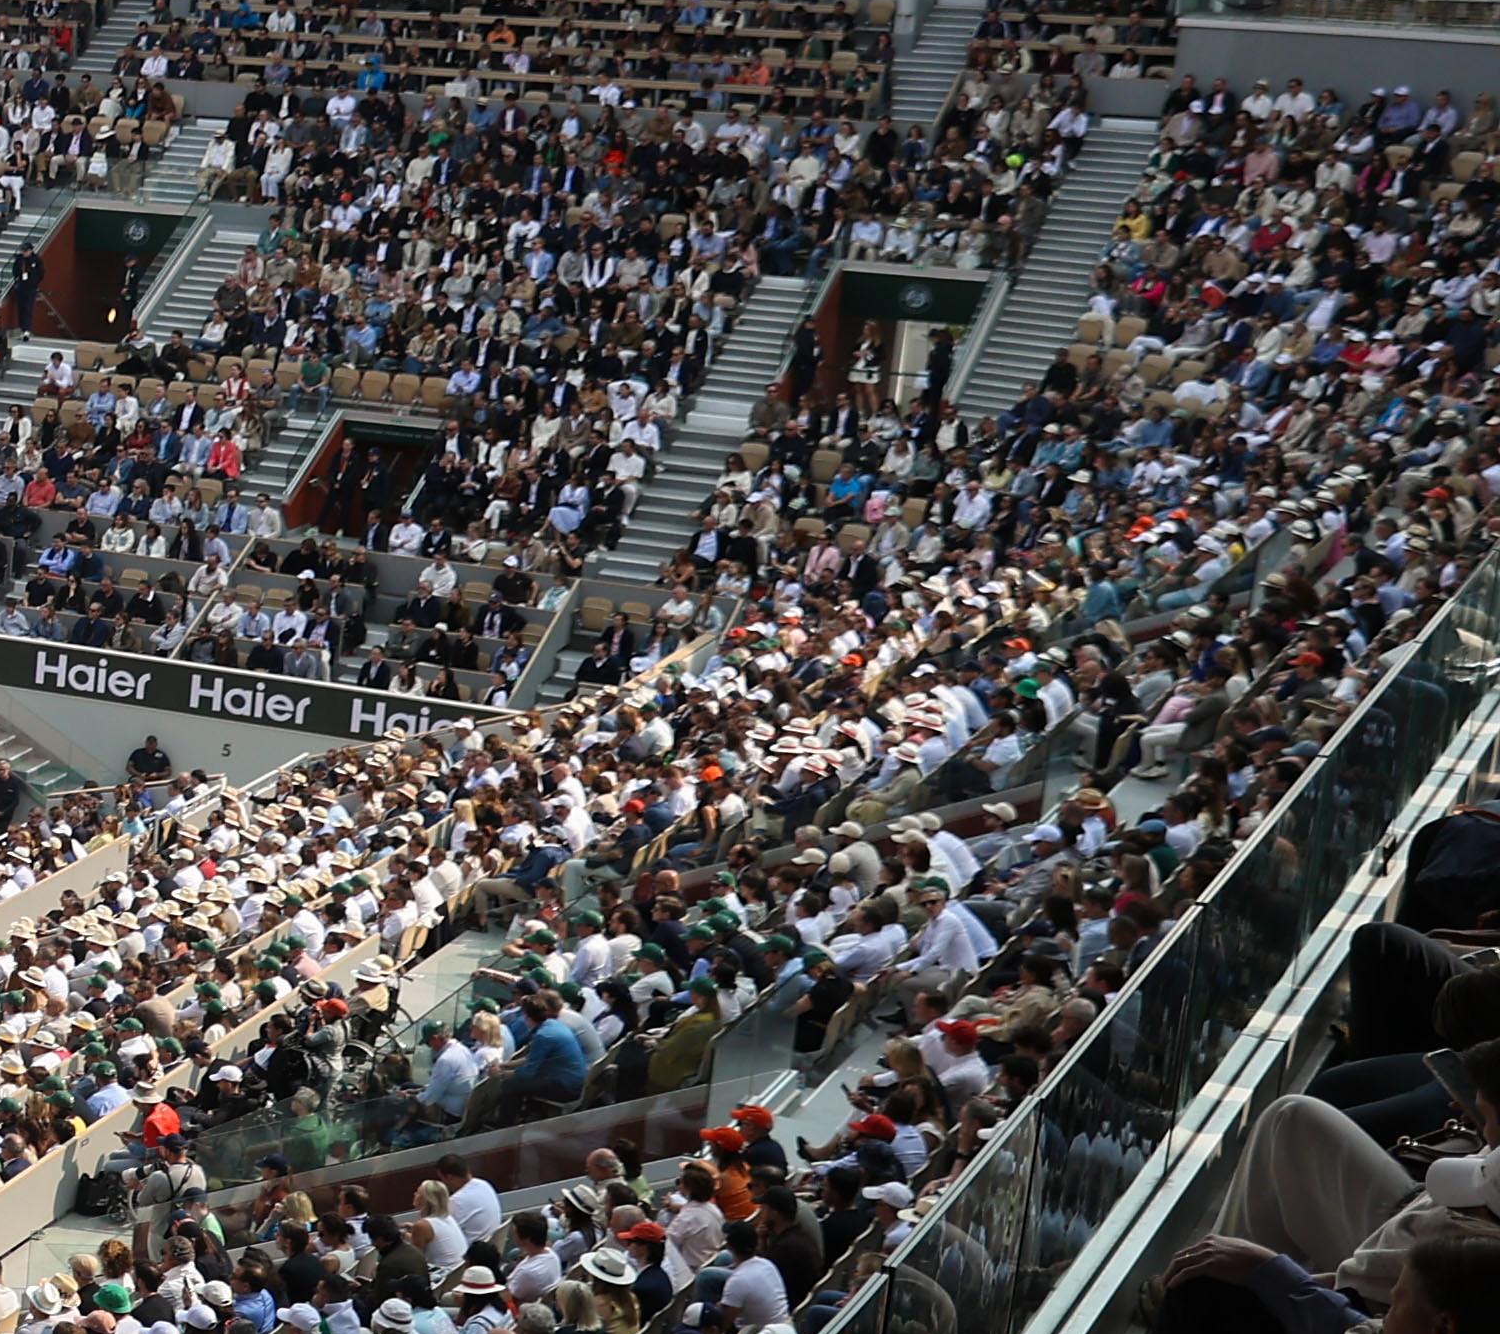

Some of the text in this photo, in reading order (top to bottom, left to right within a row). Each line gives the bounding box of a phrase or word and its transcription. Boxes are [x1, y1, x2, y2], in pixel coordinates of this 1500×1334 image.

[35, 651, 455, 737] Haier Haier Hai
[221, 743, 232, 758] 5
